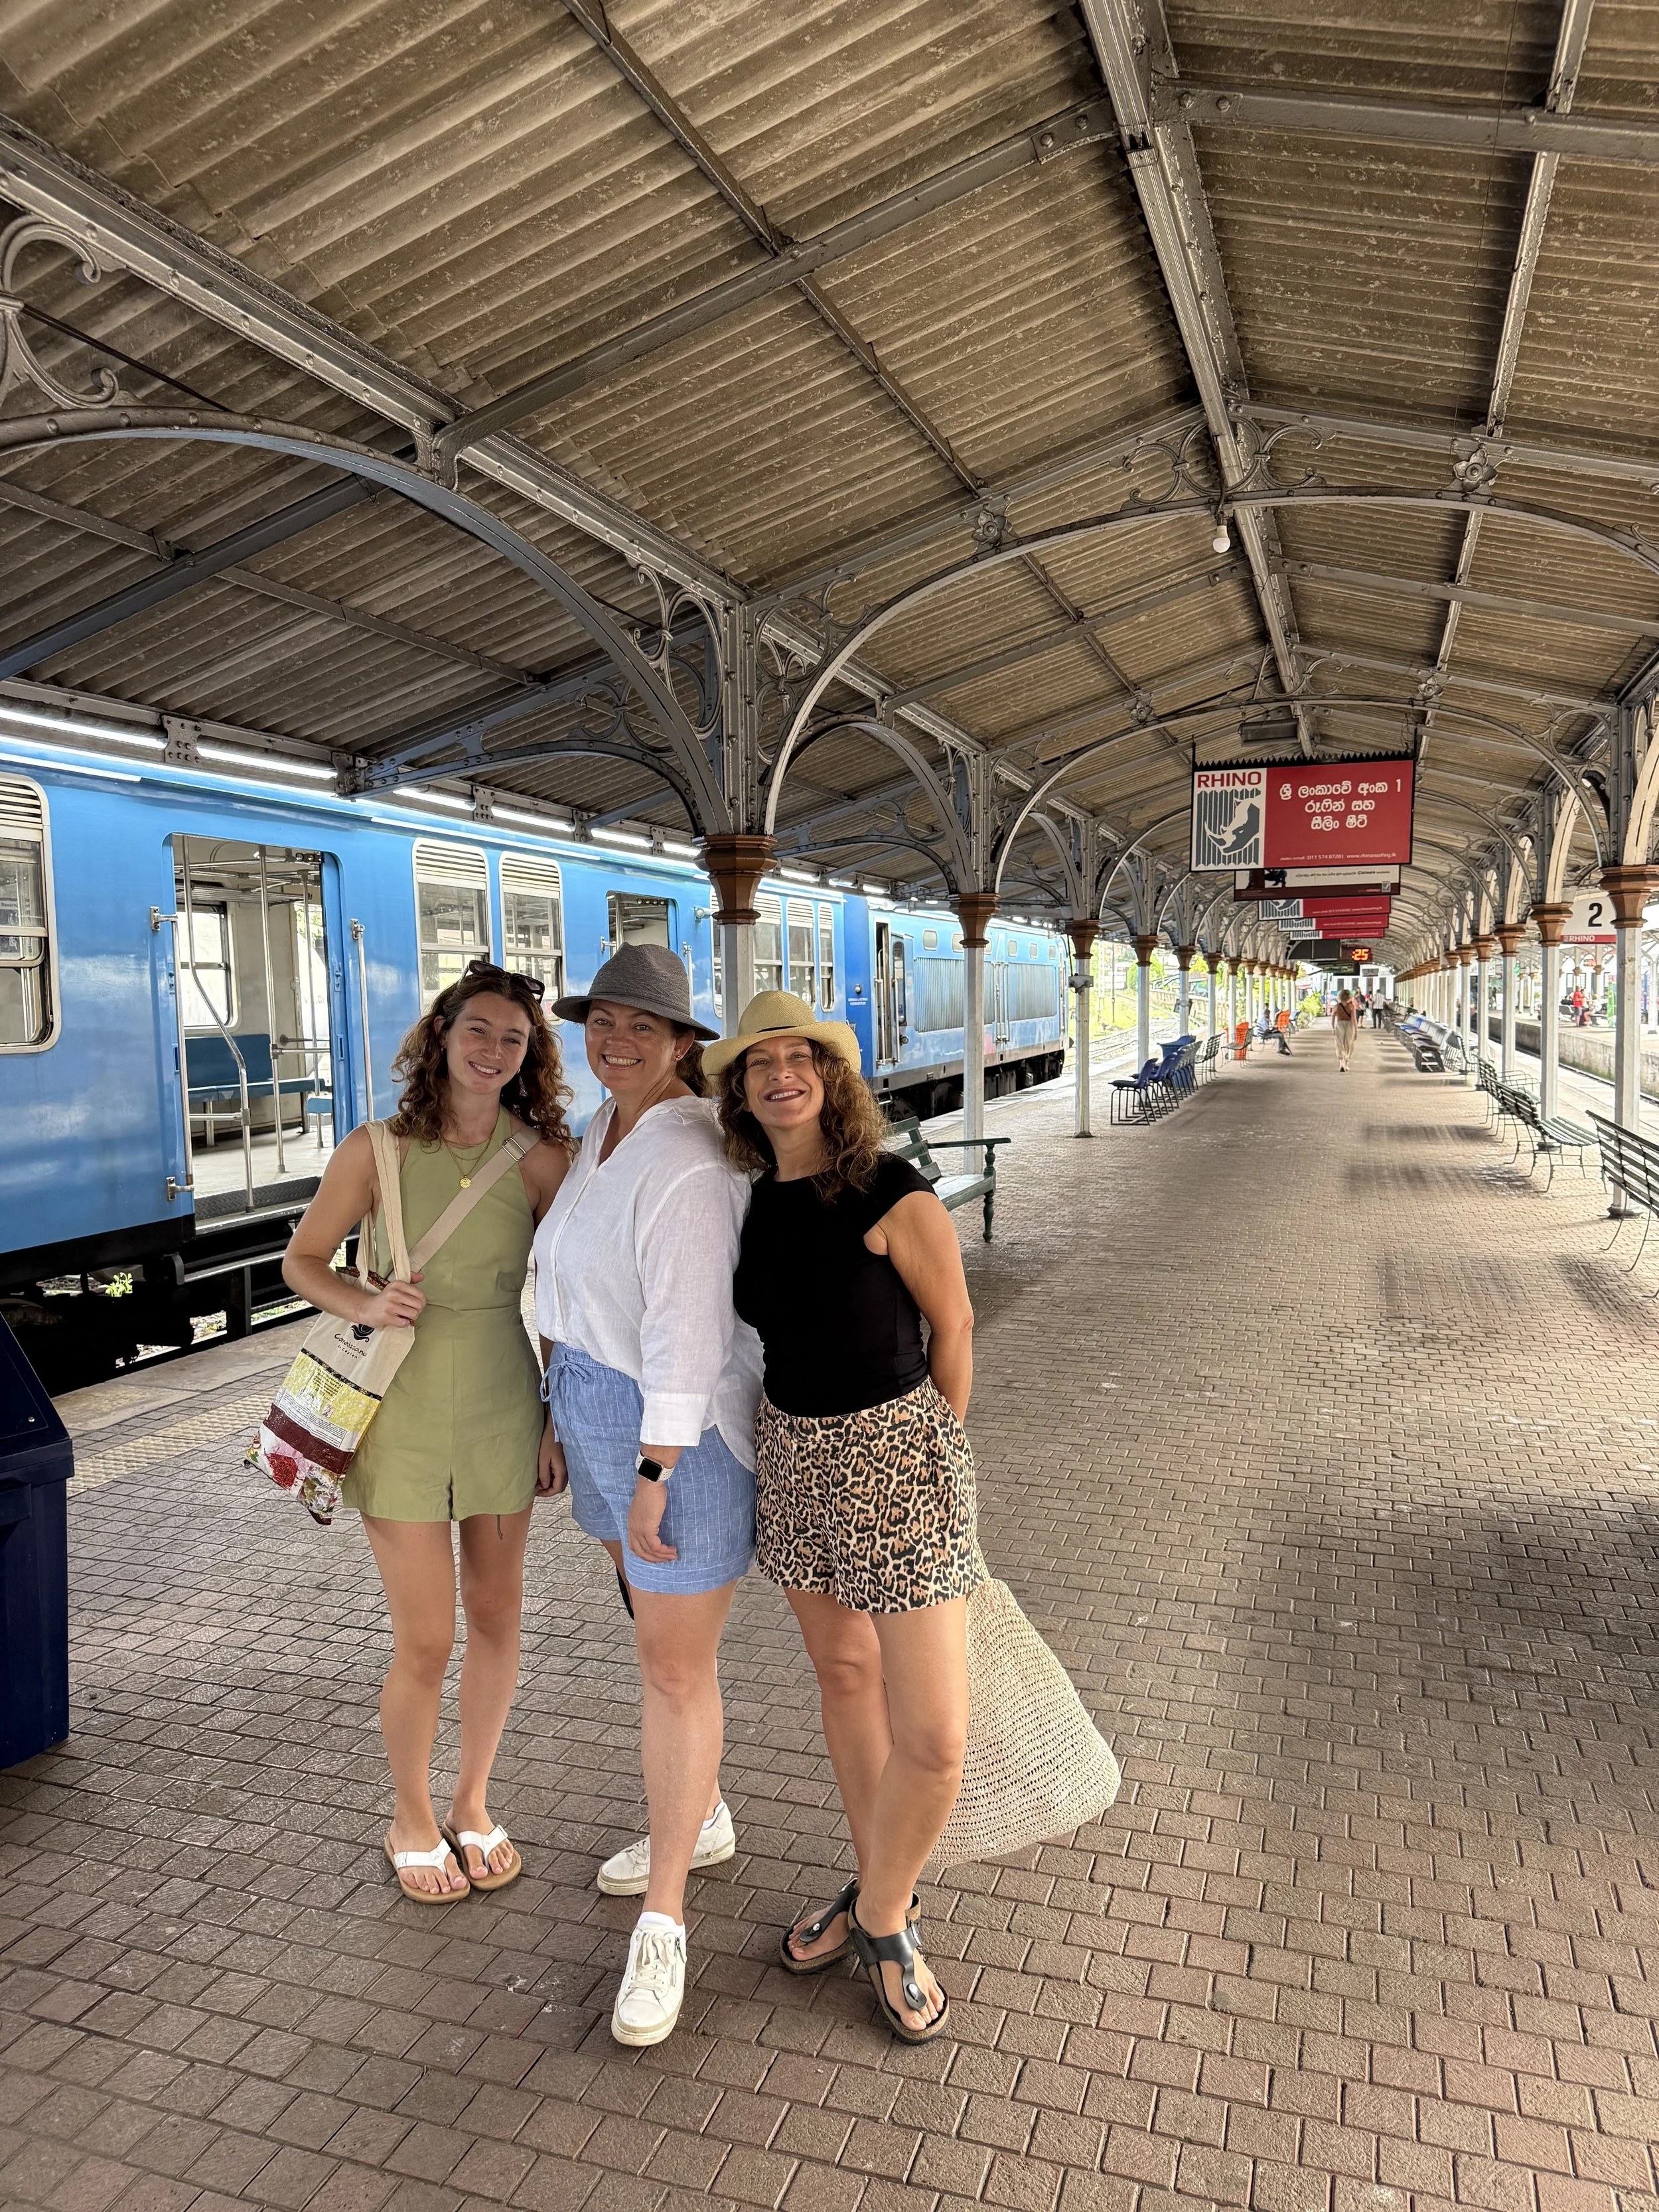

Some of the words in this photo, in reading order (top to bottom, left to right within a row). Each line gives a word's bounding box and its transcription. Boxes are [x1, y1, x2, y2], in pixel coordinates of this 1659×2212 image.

[1197, 771, 1262, 788] RHINO
[1297, 780, 1352, 798] ලංකාවේ
[1358, 782, 1388, 796] අංක
[1396, 778, 1401, 792] 1
[1351, 799, 1375, 811] සහ
[1588, 903, 1603, 927] 2
